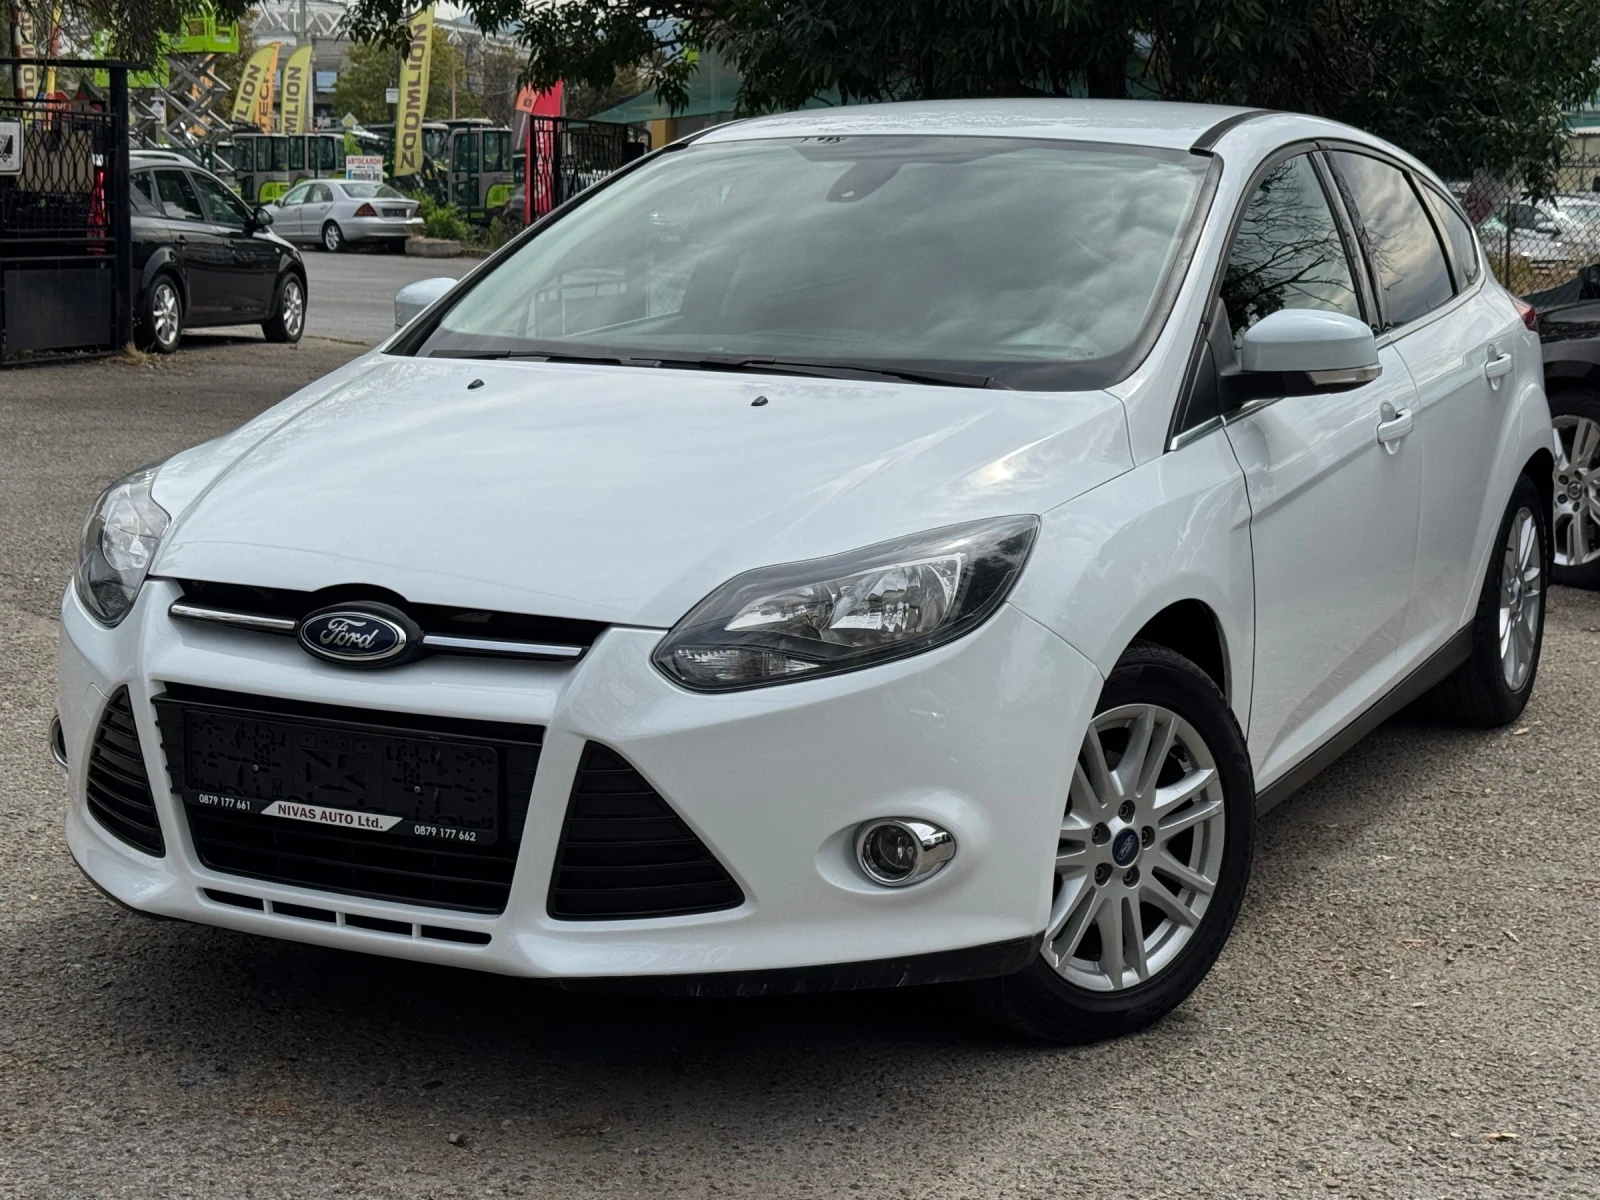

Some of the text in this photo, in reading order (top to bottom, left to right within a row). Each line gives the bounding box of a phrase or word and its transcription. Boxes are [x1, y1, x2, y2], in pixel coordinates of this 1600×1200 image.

[400, 23, 427, 169] ZOOMLION
[320, 618, 379, 648] Ford
[198, 793, 251, 811] 0879 177 661
[277, 803, 384, 830] NIVAS AUTO Ltd.
[413, 824, 477, 842] 0879 177 662
